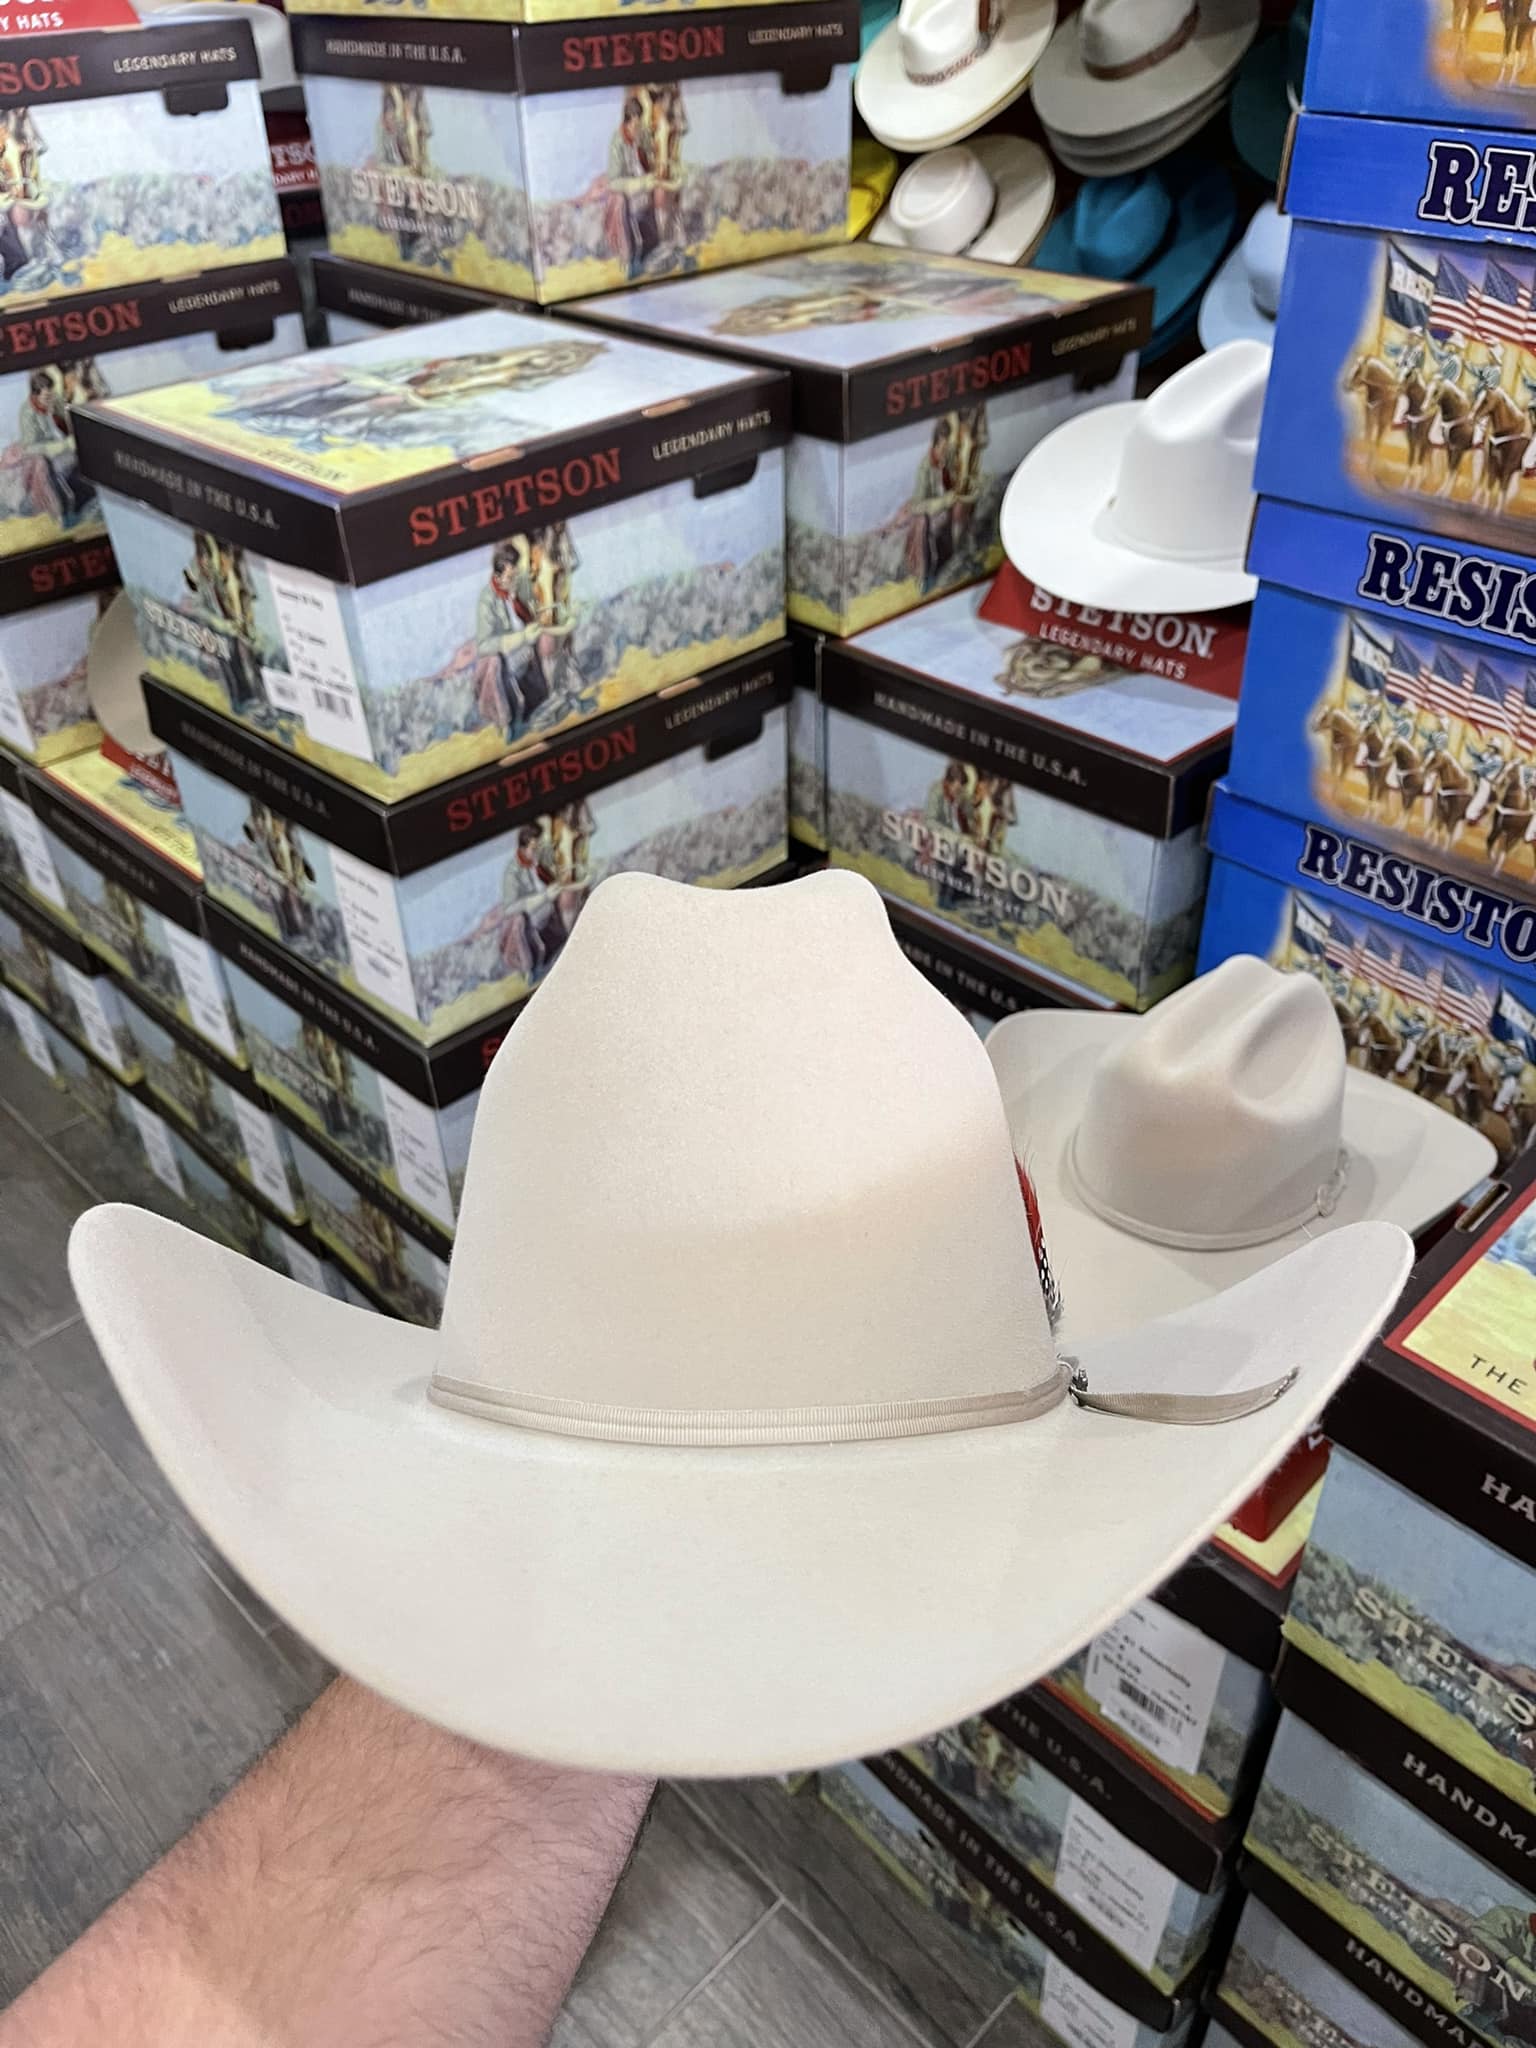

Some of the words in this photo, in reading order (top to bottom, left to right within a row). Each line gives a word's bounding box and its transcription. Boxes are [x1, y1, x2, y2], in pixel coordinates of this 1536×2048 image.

[16, 11, 64, 30] HATS
[563, 25, 725, 73] STETSON
[113, 51, 196, 73] LEGENDARY
[200, 47, 238, 63] HATS
[388, 44, 401, 57] IN
[404, 44, 427, 61] THE
[429, 46, 467, 63] U.S.A.
[352, 169, 482, 220] STETSON
[1417, 138, 1536, 233] RE
[0, 299, 143, 353] ETSON
[885, 342, 1033, 417] STETSON
[652, 421, 735, 461] LEGENDARY
[735, 409, 771, 432] HATS
[114, 450, 184, 493] HANDMADE
[186, 480, 200, 498] IN
[204, 484, 232, 513] THE
[235, 496, 280, 530] U.S.A.
[408, 448, 622, 546] STETSON
[29, 544, 113, 593] STE
[141, 598, 232, 660] STETSON
[1030, 588, 1217, 660] STETSON
[1039, 622, 1138, 664] LEGENDARY
[1141, 654, 1188, 681] HATS
[873, 689, 967, 740] HANDMADE
[969, 726, 990, 748] IN
[993, 735, 1029, 763] THE
[1032, 749, 1088, 788] U.S.A.
[446, 725, 638, 832] STETSON
[881, 809, 1071, 917] STETSON
[1297, 821, 1536, 964] RESISTO
[1471, 1353, 1528, 1396] THE
[1047, 1736, 1112, 1801] U.S.A.
[985, 1855, 1022, 1896] THE
[1025, 1891, 1083, 1953] U.S.A.
[1307, 1823, 1532, 2002] STETSON
